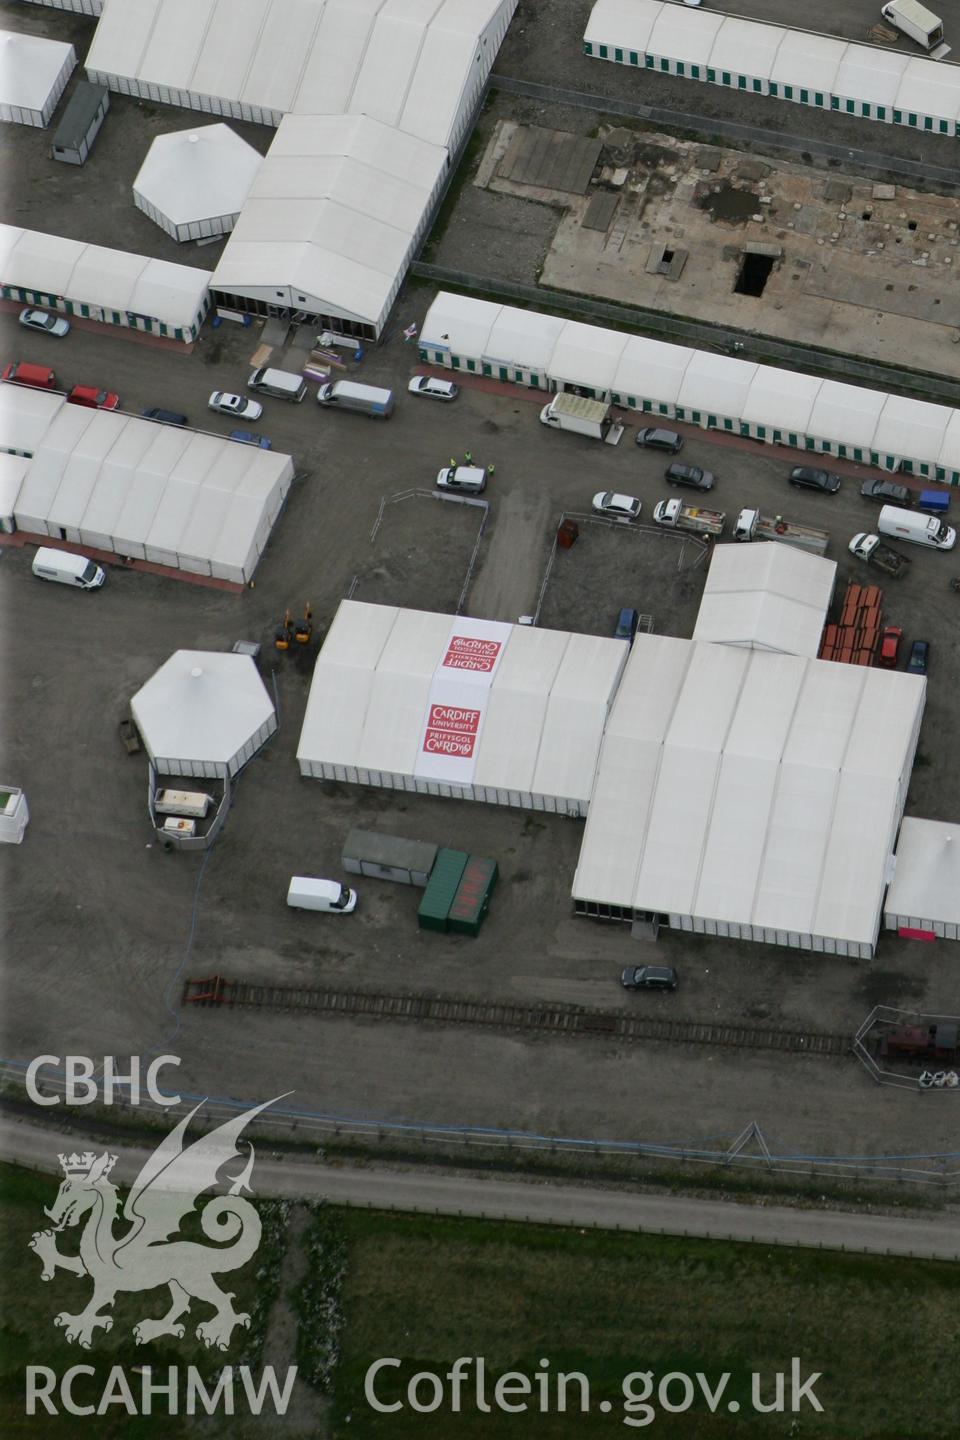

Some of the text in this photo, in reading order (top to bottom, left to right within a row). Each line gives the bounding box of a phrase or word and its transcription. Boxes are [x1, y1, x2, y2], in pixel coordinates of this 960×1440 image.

[445, 658, 491, 671] CARDIFF
[432, 706, 479, 723] CARDIFF
[432, 719, 474, 731] UNIVERSITY
[429, 732, 471, 743] PRIFYSGOL
